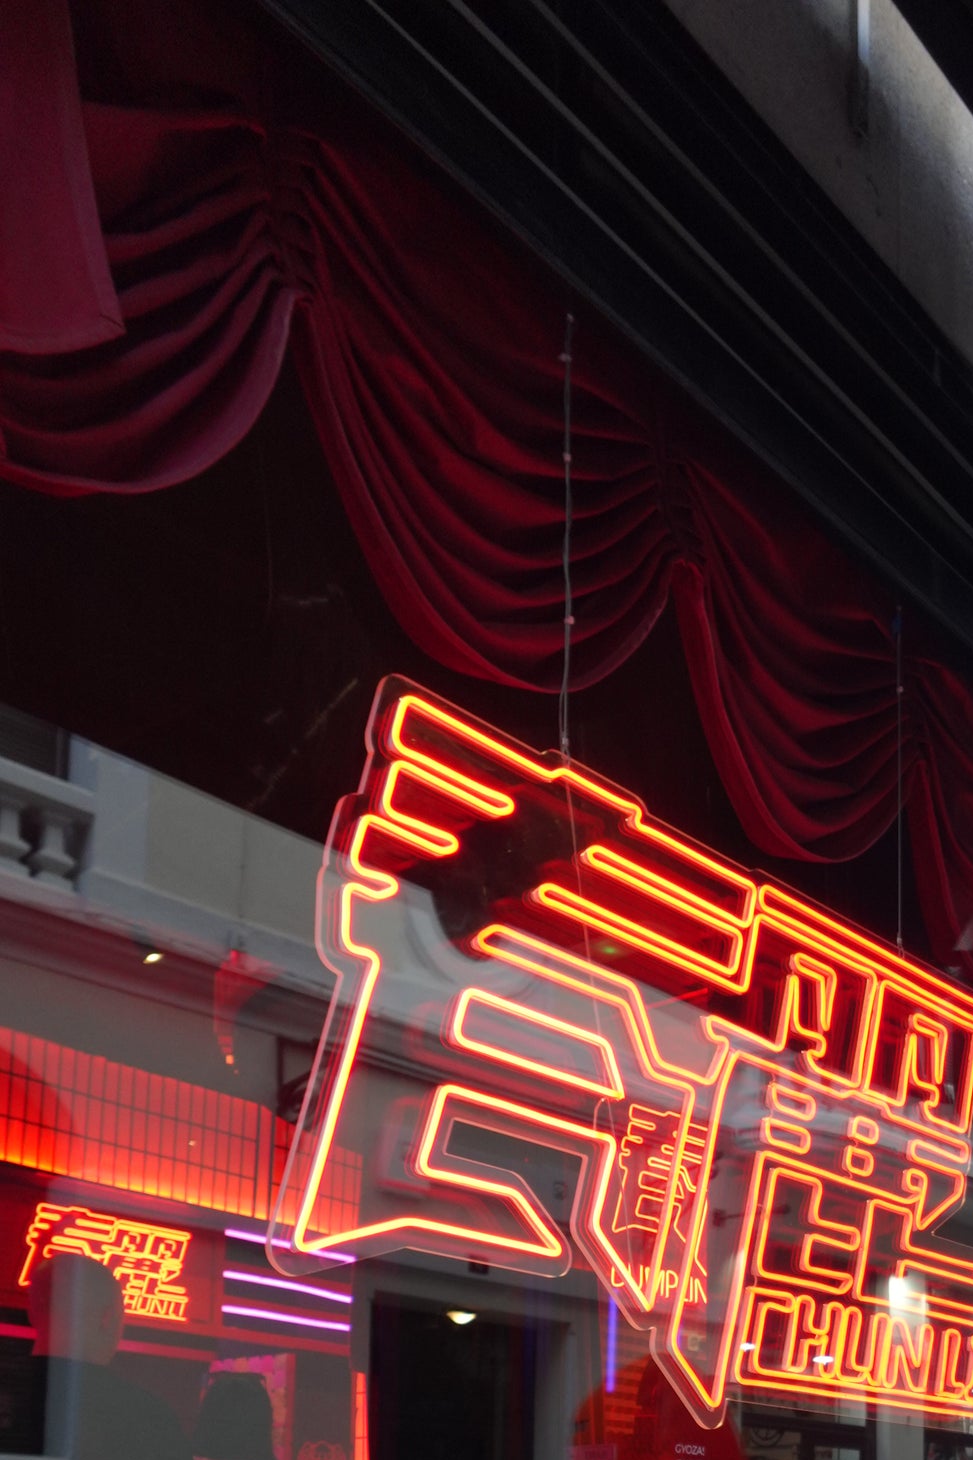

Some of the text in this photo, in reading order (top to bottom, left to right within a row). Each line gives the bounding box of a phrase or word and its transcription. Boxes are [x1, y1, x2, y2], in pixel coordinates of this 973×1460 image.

[122, 1293, 168, 1315] HUN
[734, 1286, 934, 1395] CHUN
[674, 1443, 705, 1456] GYOZA
